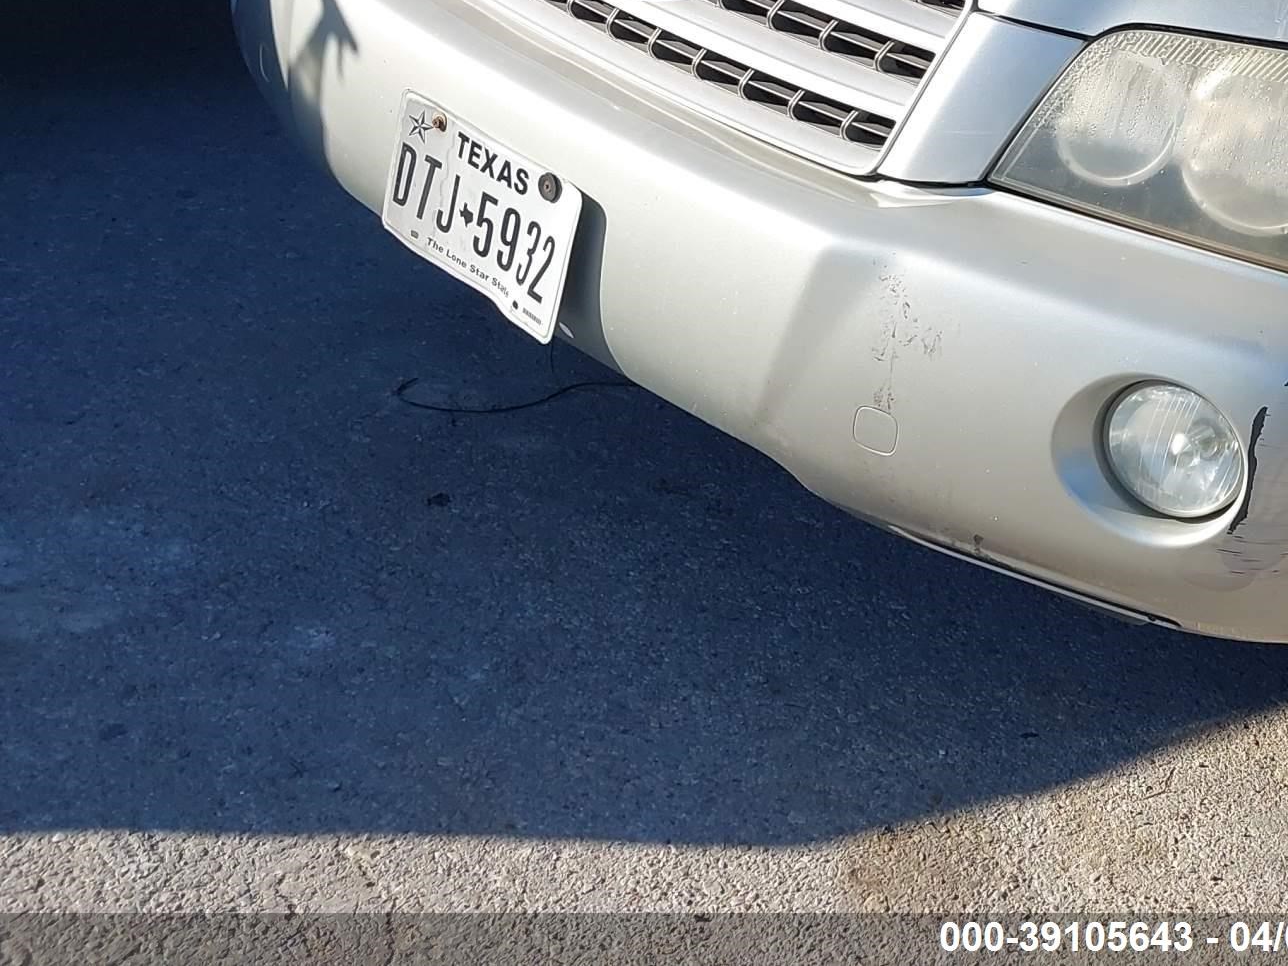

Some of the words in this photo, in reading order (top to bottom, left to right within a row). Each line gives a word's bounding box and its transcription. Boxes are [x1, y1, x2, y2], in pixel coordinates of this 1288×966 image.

[458, 131, 530, 195] TEXAS
[426, 237, 444, 253] The
[446, 248, 467, 268] Lone
[469, 264, 490, 283] Star
